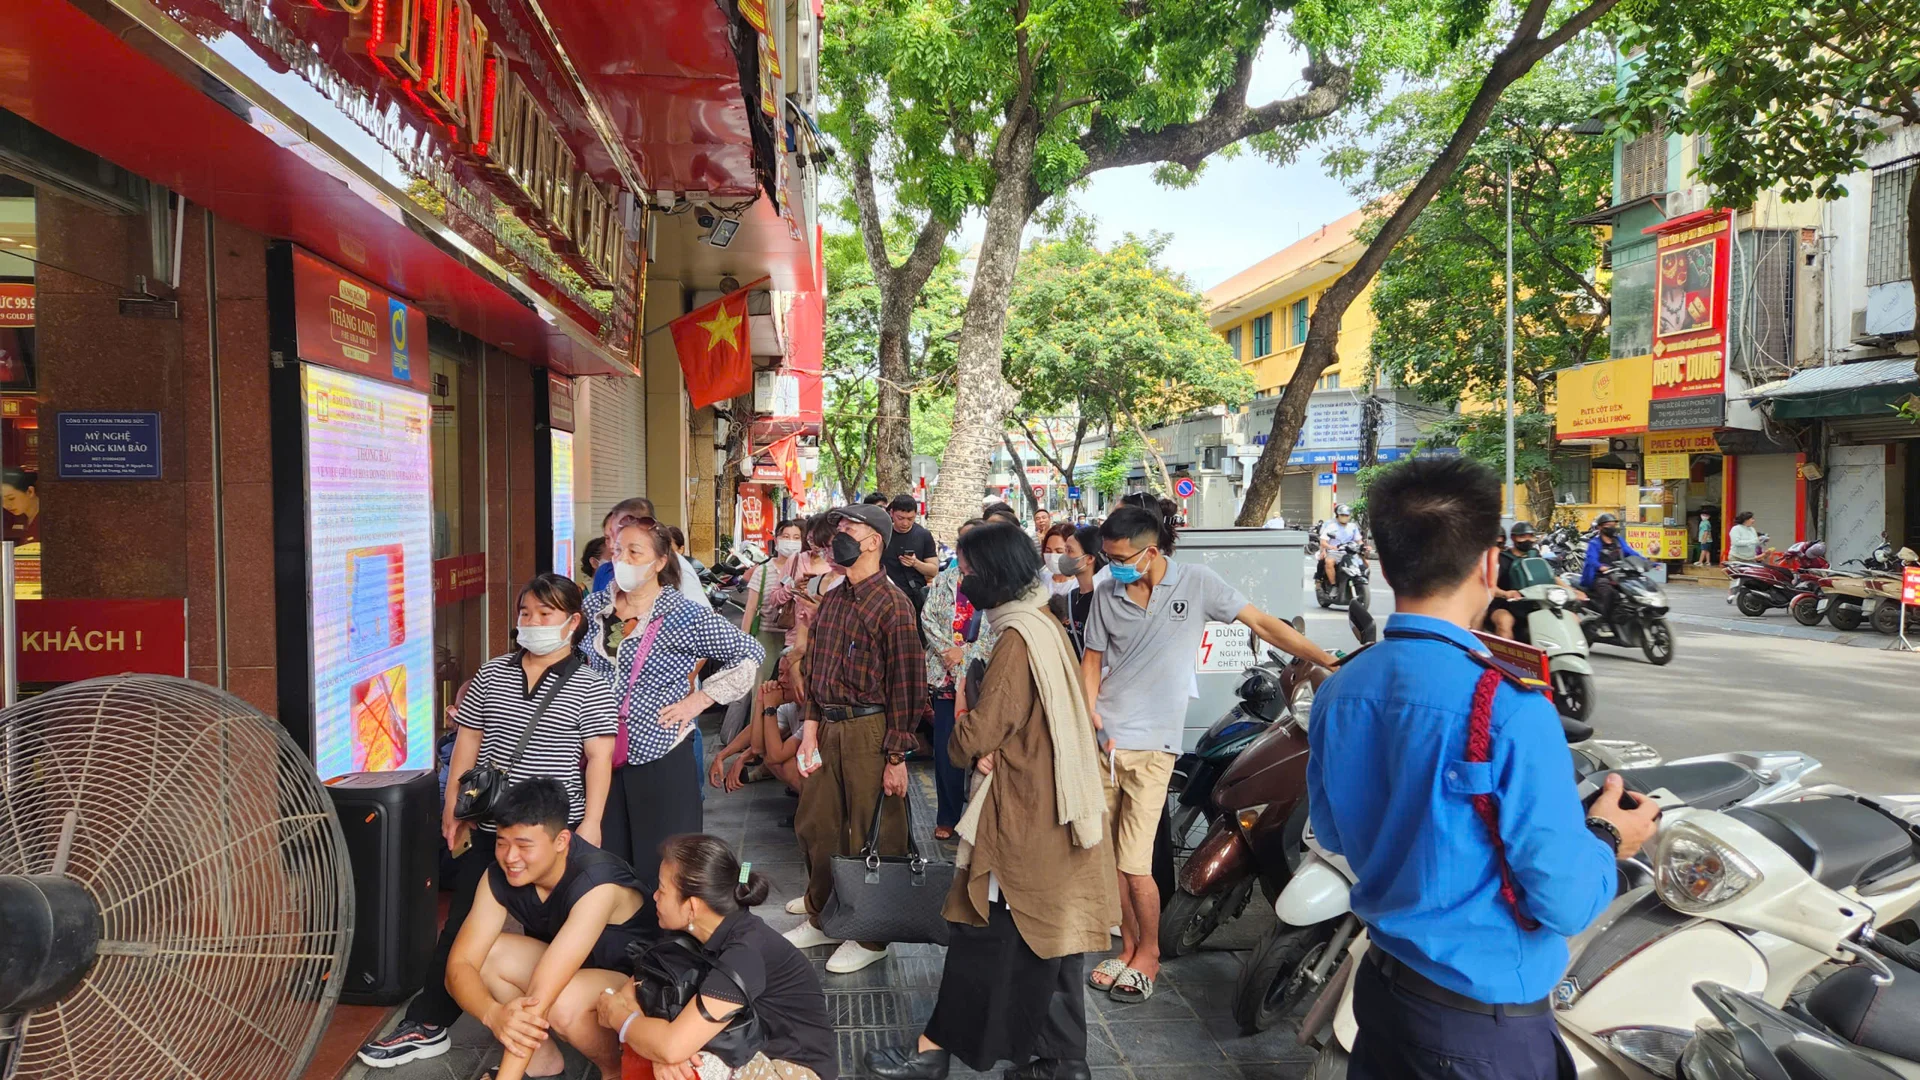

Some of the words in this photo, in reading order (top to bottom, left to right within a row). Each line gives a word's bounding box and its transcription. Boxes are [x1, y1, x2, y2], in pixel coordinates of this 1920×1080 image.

[331, 308, 357, 332] THĂNG
[358, 318, 375, 338] LONG
[1653, 356, 1686, 388] NGỌC
[1686, 351, 1722, 382] DUNG
[85, 430, 100, 440] MỸ
[102, 430, 131, 442] NGHỆ
[70, 442, 105, 452] HOÀNG
[128, 442, 147, 452] BẢO
[1651, 440, 1672, 449] PATE
[1674, 437, 1692, 449] CỘT
[1327, 452, 1345, 461] TRẦN
[1216, 627, 1244, 637] DỪNG
[22, 626, 124, 652] KHÁCH
[135, 630, 142, 651] !
[1218, 659, 1238, 667] CHẾT
